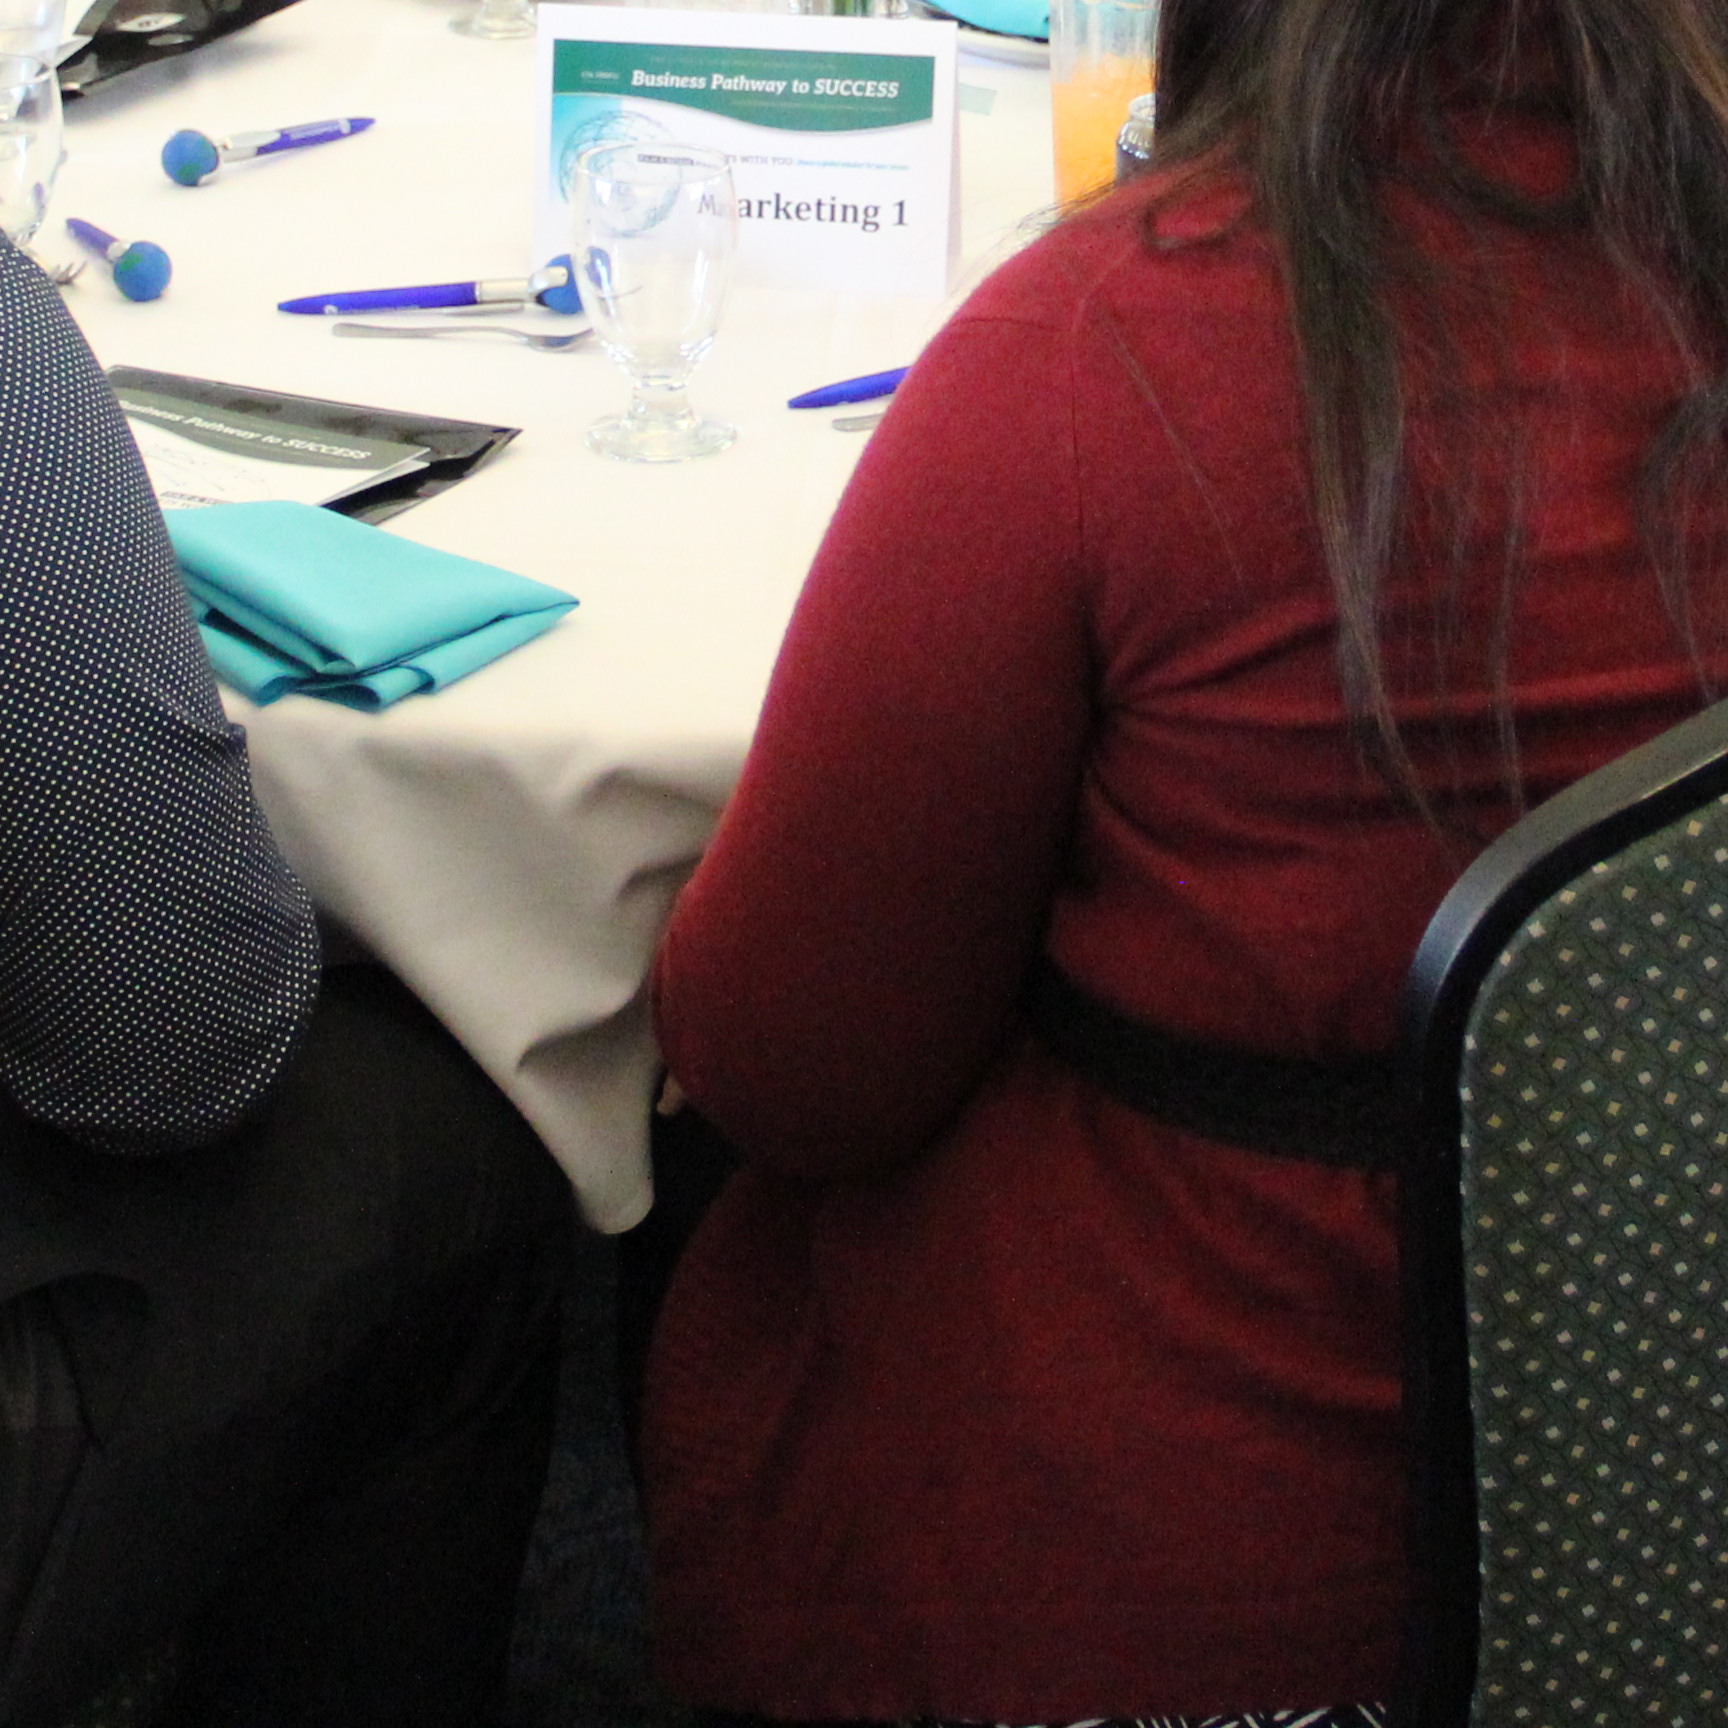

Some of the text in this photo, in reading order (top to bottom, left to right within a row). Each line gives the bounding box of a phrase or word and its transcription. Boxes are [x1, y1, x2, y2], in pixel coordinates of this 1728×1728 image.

[630, 69, 707, 90] Business
[710, 73, 787, 96] Pathway
[791, 78, 811, 95] to
[813, 77, 900, 99] SUCCESS
[892, 199, 909, 227] 1
[182, 416, 262, 440] Pathway
[261, 434, 283, 445] to
[282, 437, 372, 460] SUCCESS
